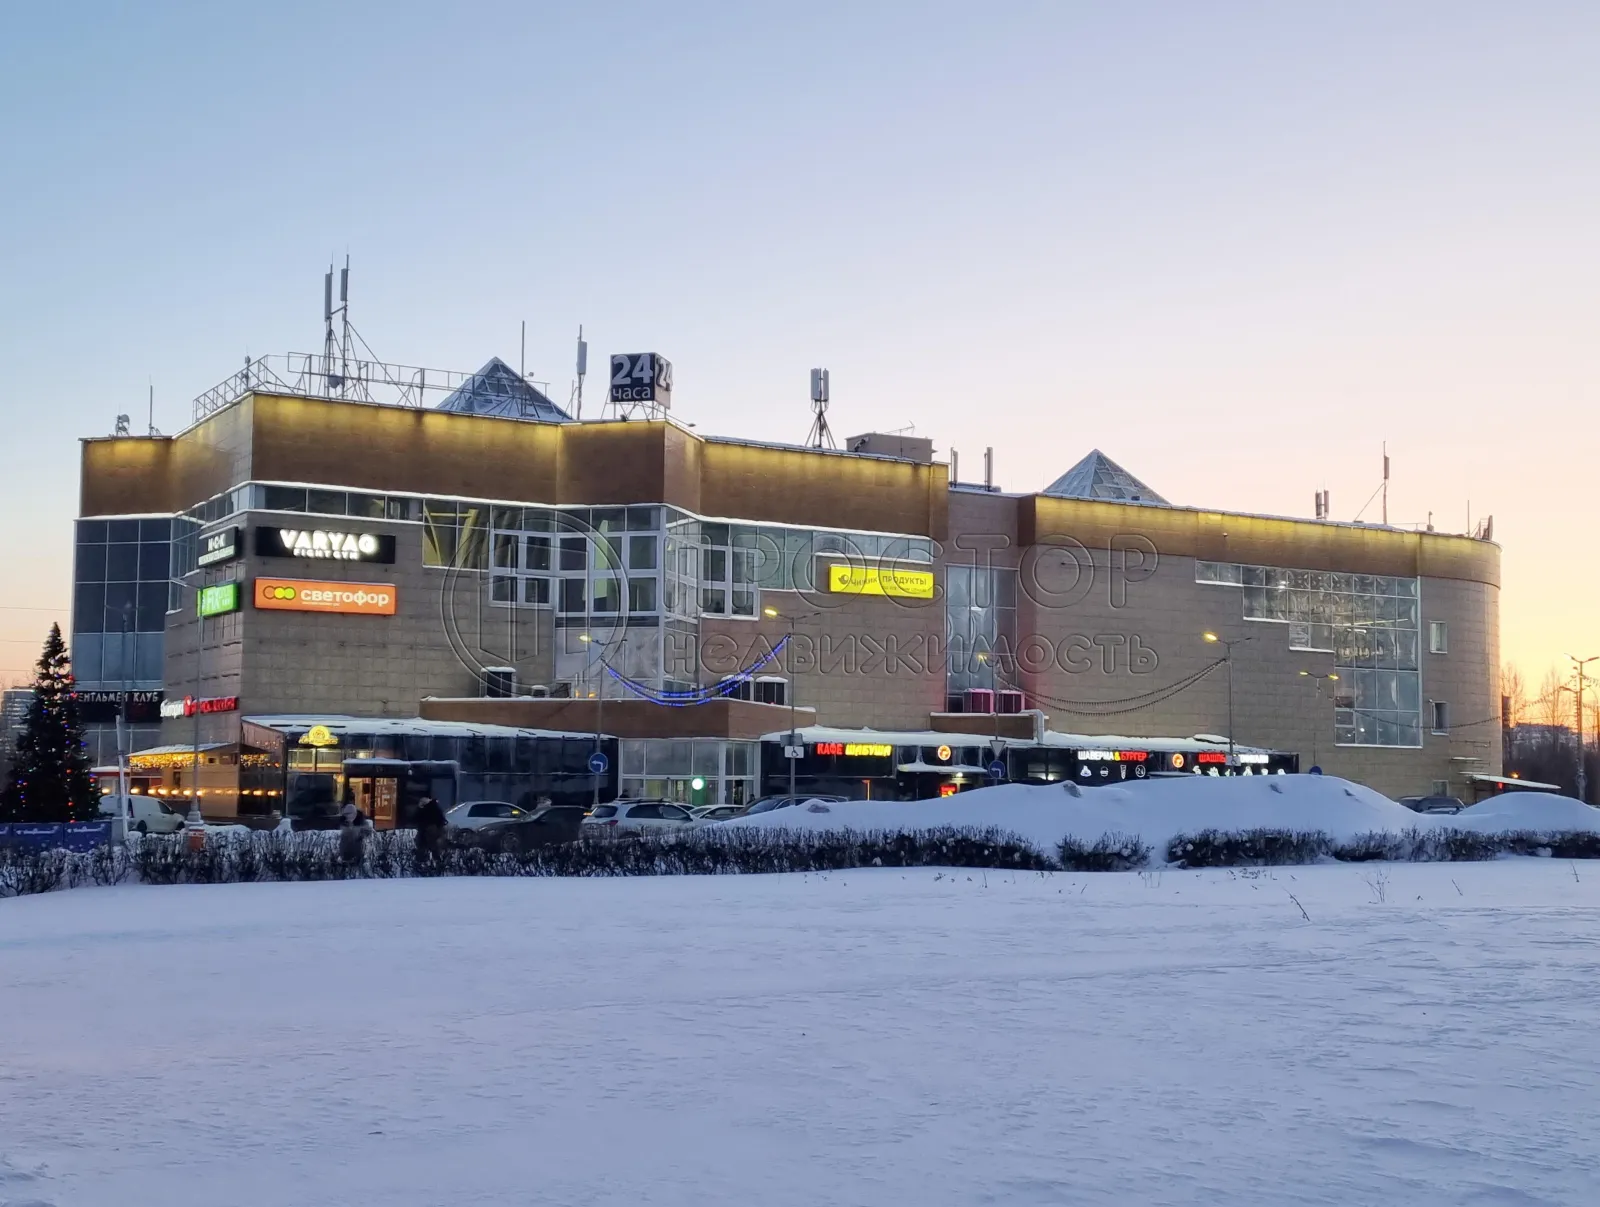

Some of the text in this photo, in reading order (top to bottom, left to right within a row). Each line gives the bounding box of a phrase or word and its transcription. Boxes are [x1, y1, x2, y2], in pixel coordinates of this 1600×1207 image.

[612, 353, 653, 385] 24
[613, 386, 651, 399] часа
[280, 529, 377, 554] VARYAG
[293, 548, 360, 560] FIGHT GYM
[882, 575, 927, 586] ПРОДУКТЫ
[300, 589, 389, 607] светофор
[132, 692, 159, 703] КЛУБ
[817, 743, 843, 755] КАФЕ
